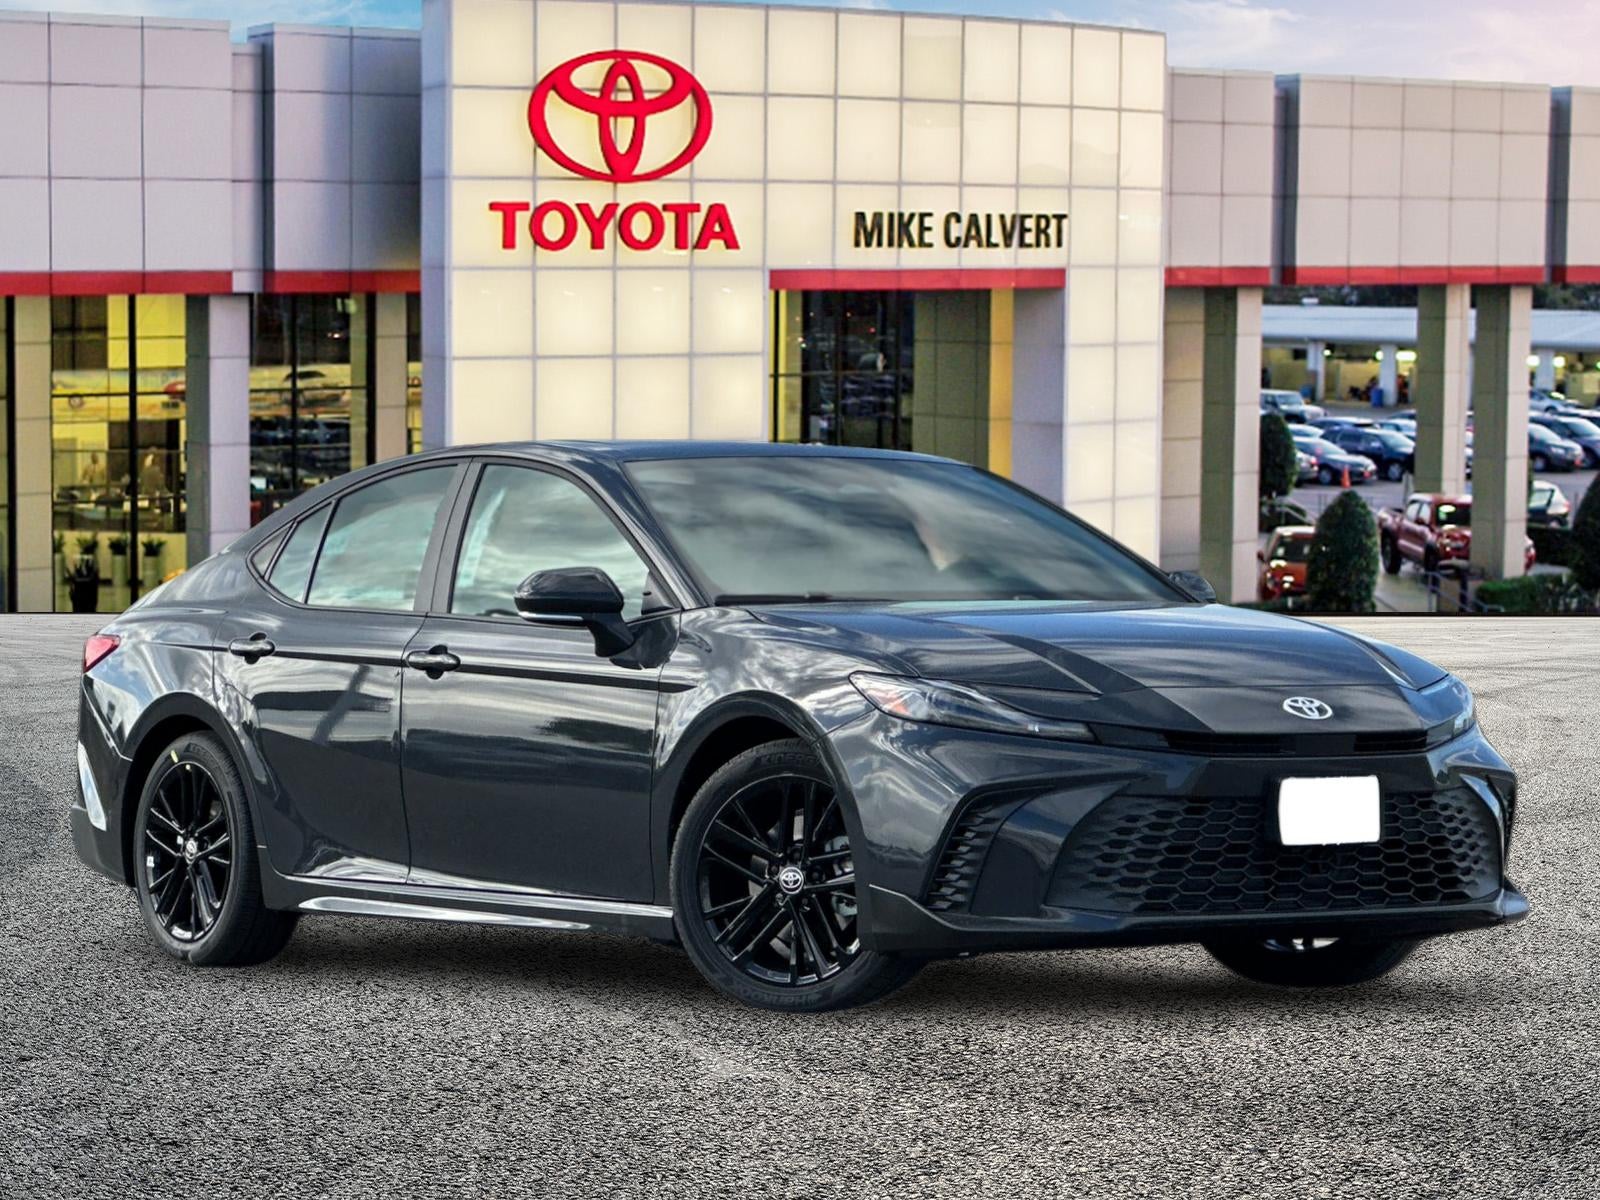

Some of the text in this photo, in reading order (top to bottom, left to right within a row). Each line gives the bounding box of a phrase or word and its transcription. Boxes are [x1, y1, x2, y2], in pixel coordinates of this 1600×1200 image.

[489, 200, 740, 251] TOYOTA
[854, 212, 1068, 248] MIKE CALVERT
